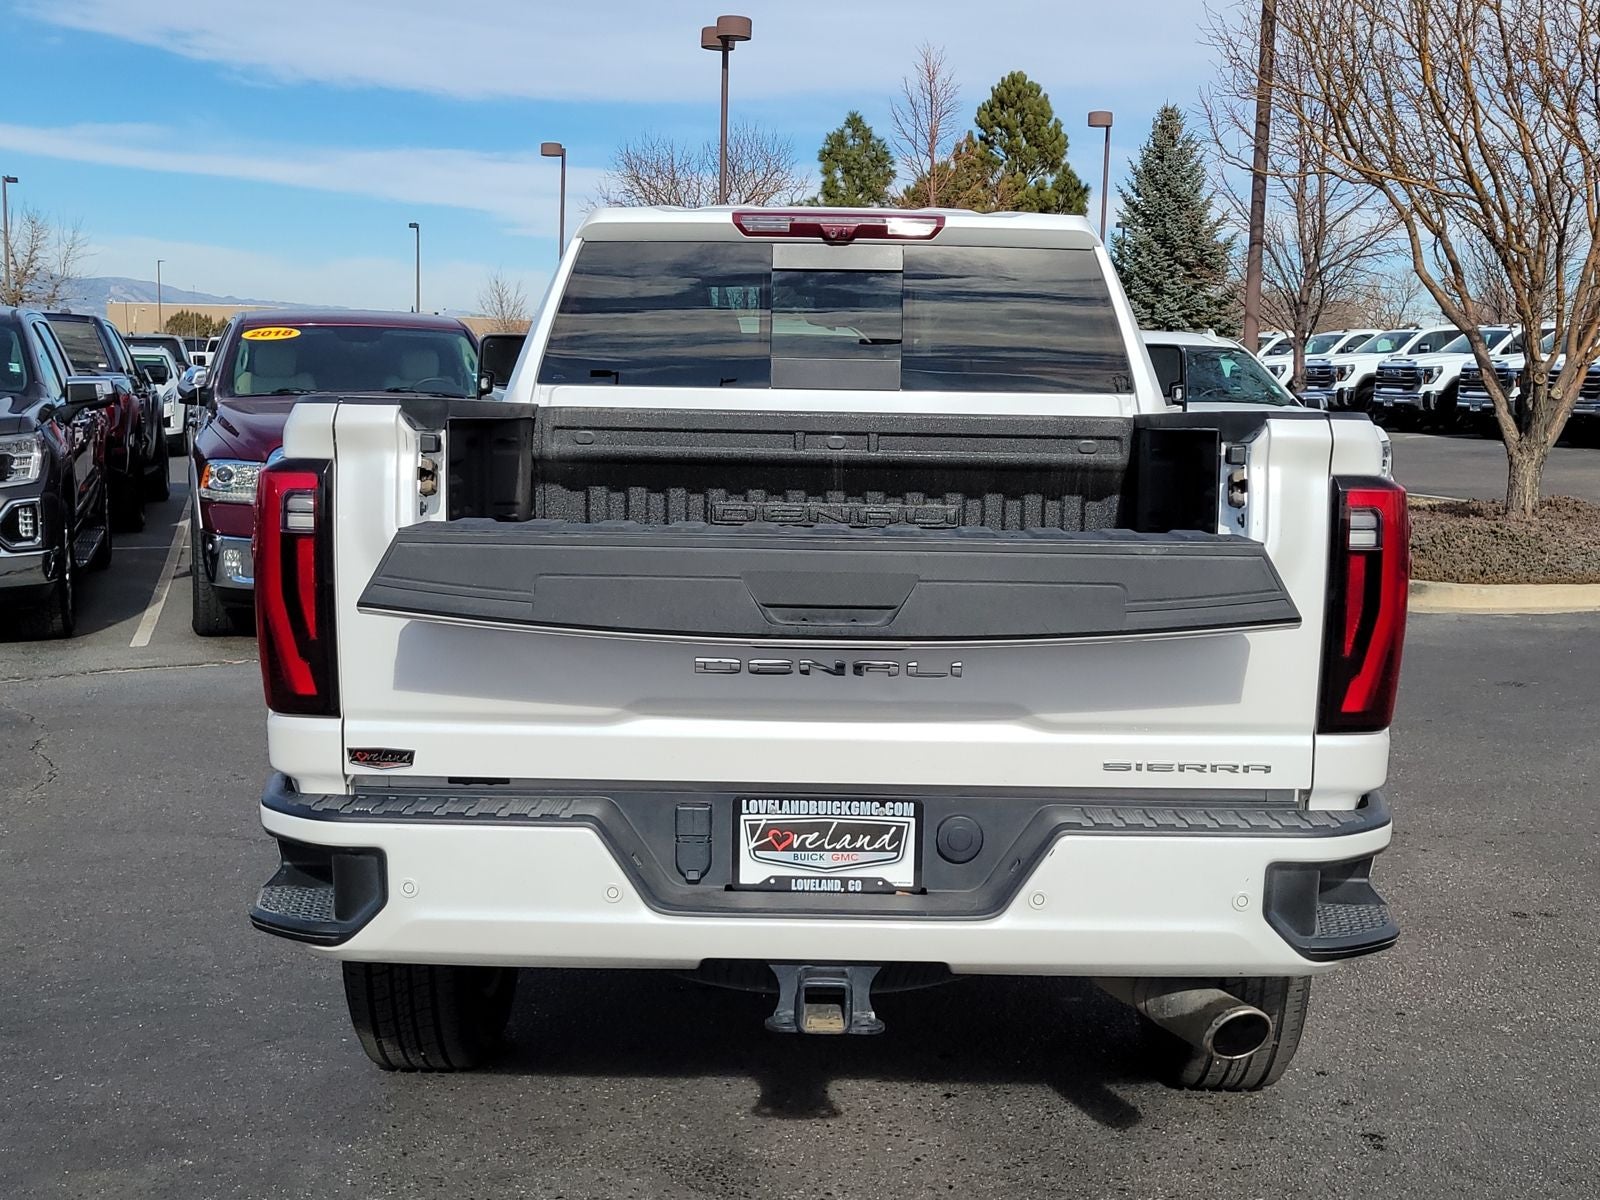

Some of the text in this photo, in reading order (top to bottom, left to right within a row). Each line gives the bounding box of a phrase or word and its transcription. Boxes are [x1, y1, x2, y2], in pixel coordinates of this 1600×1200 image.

[248, 329, 294, 338] 2018
[711, 502, 960, 526] DENALI
[694, 657, 963, 678] DENALI
[1102, 761, 1272, 774] SIERRA
[741, 799, 915, 817] LOVELANDBUICKGMCCOM
[793, 853, 859, 862] BUICK GMC
[791, 878, 862, 892] LOVELAND, CO
